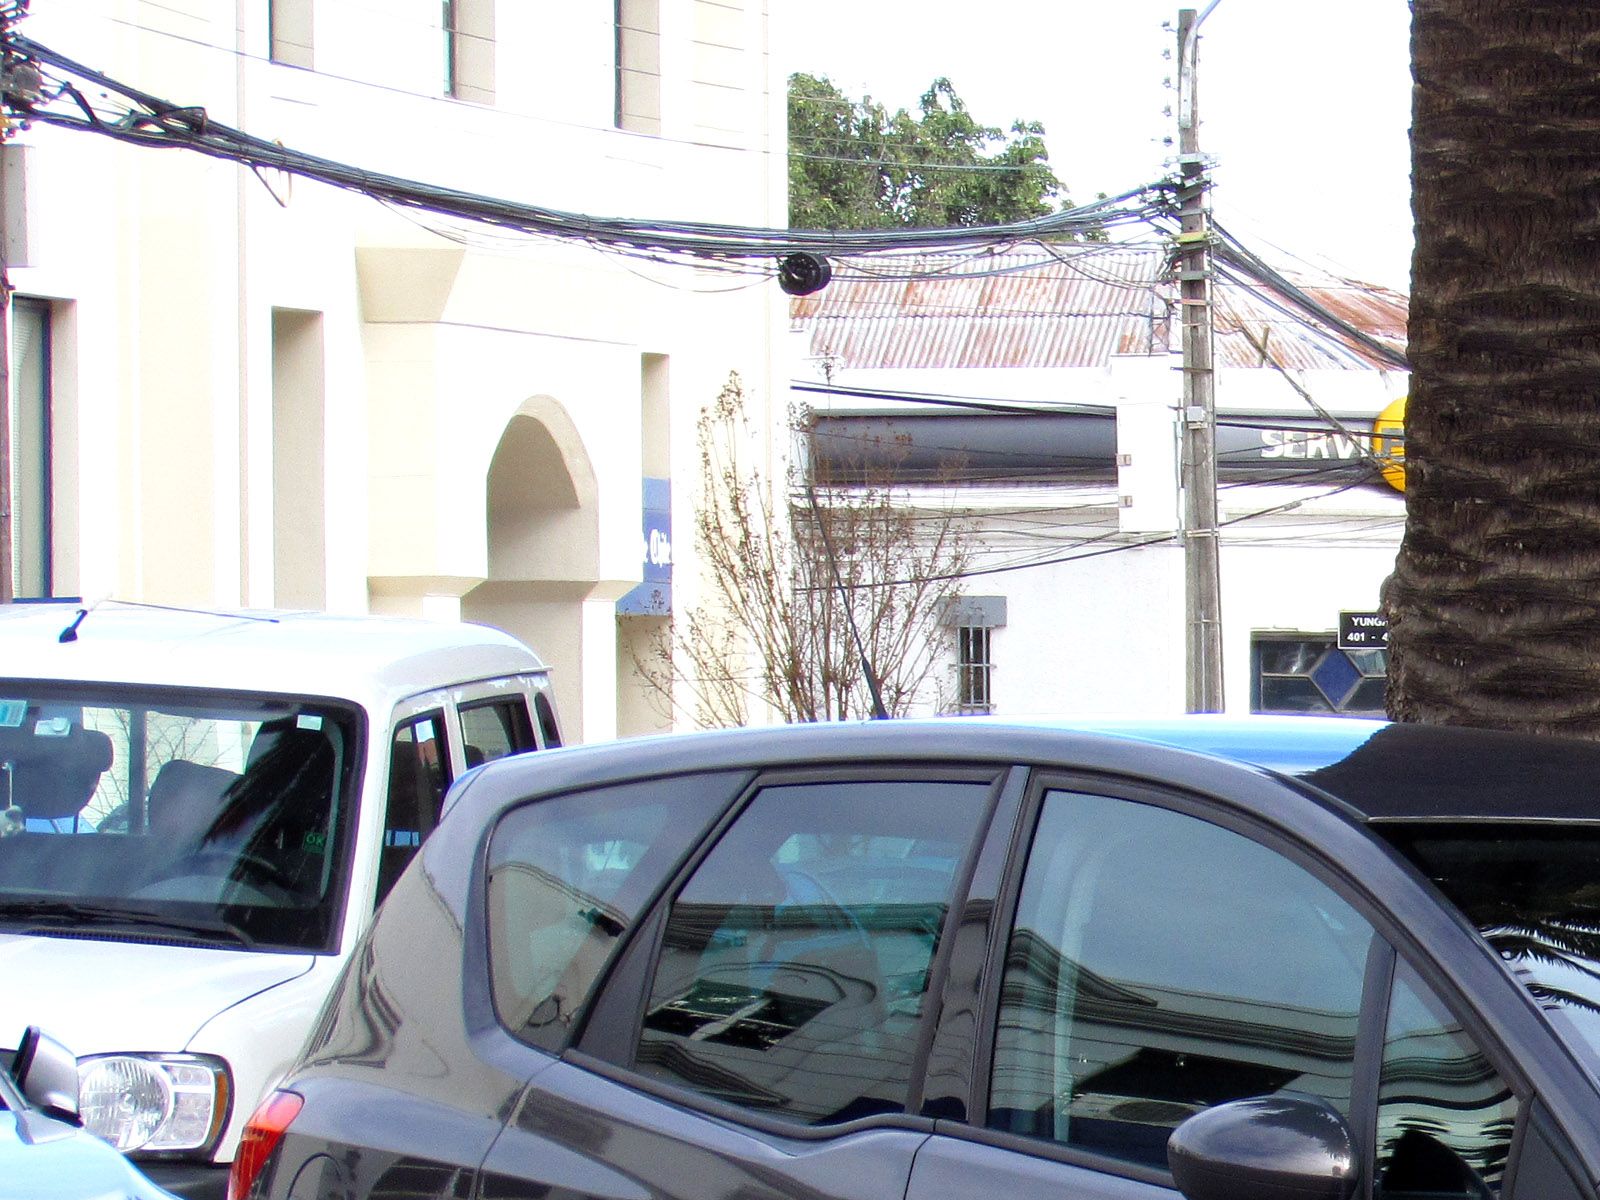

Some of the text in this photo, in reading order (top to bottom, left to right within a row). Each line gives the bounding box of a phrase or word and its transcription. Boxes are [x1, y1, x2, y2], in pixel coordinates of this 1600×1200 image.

[1260, 429, 1370, 459] SERVI
[1351, 616, 1389, 627] YUNG
[1346, 632, 1365, 642] 401
